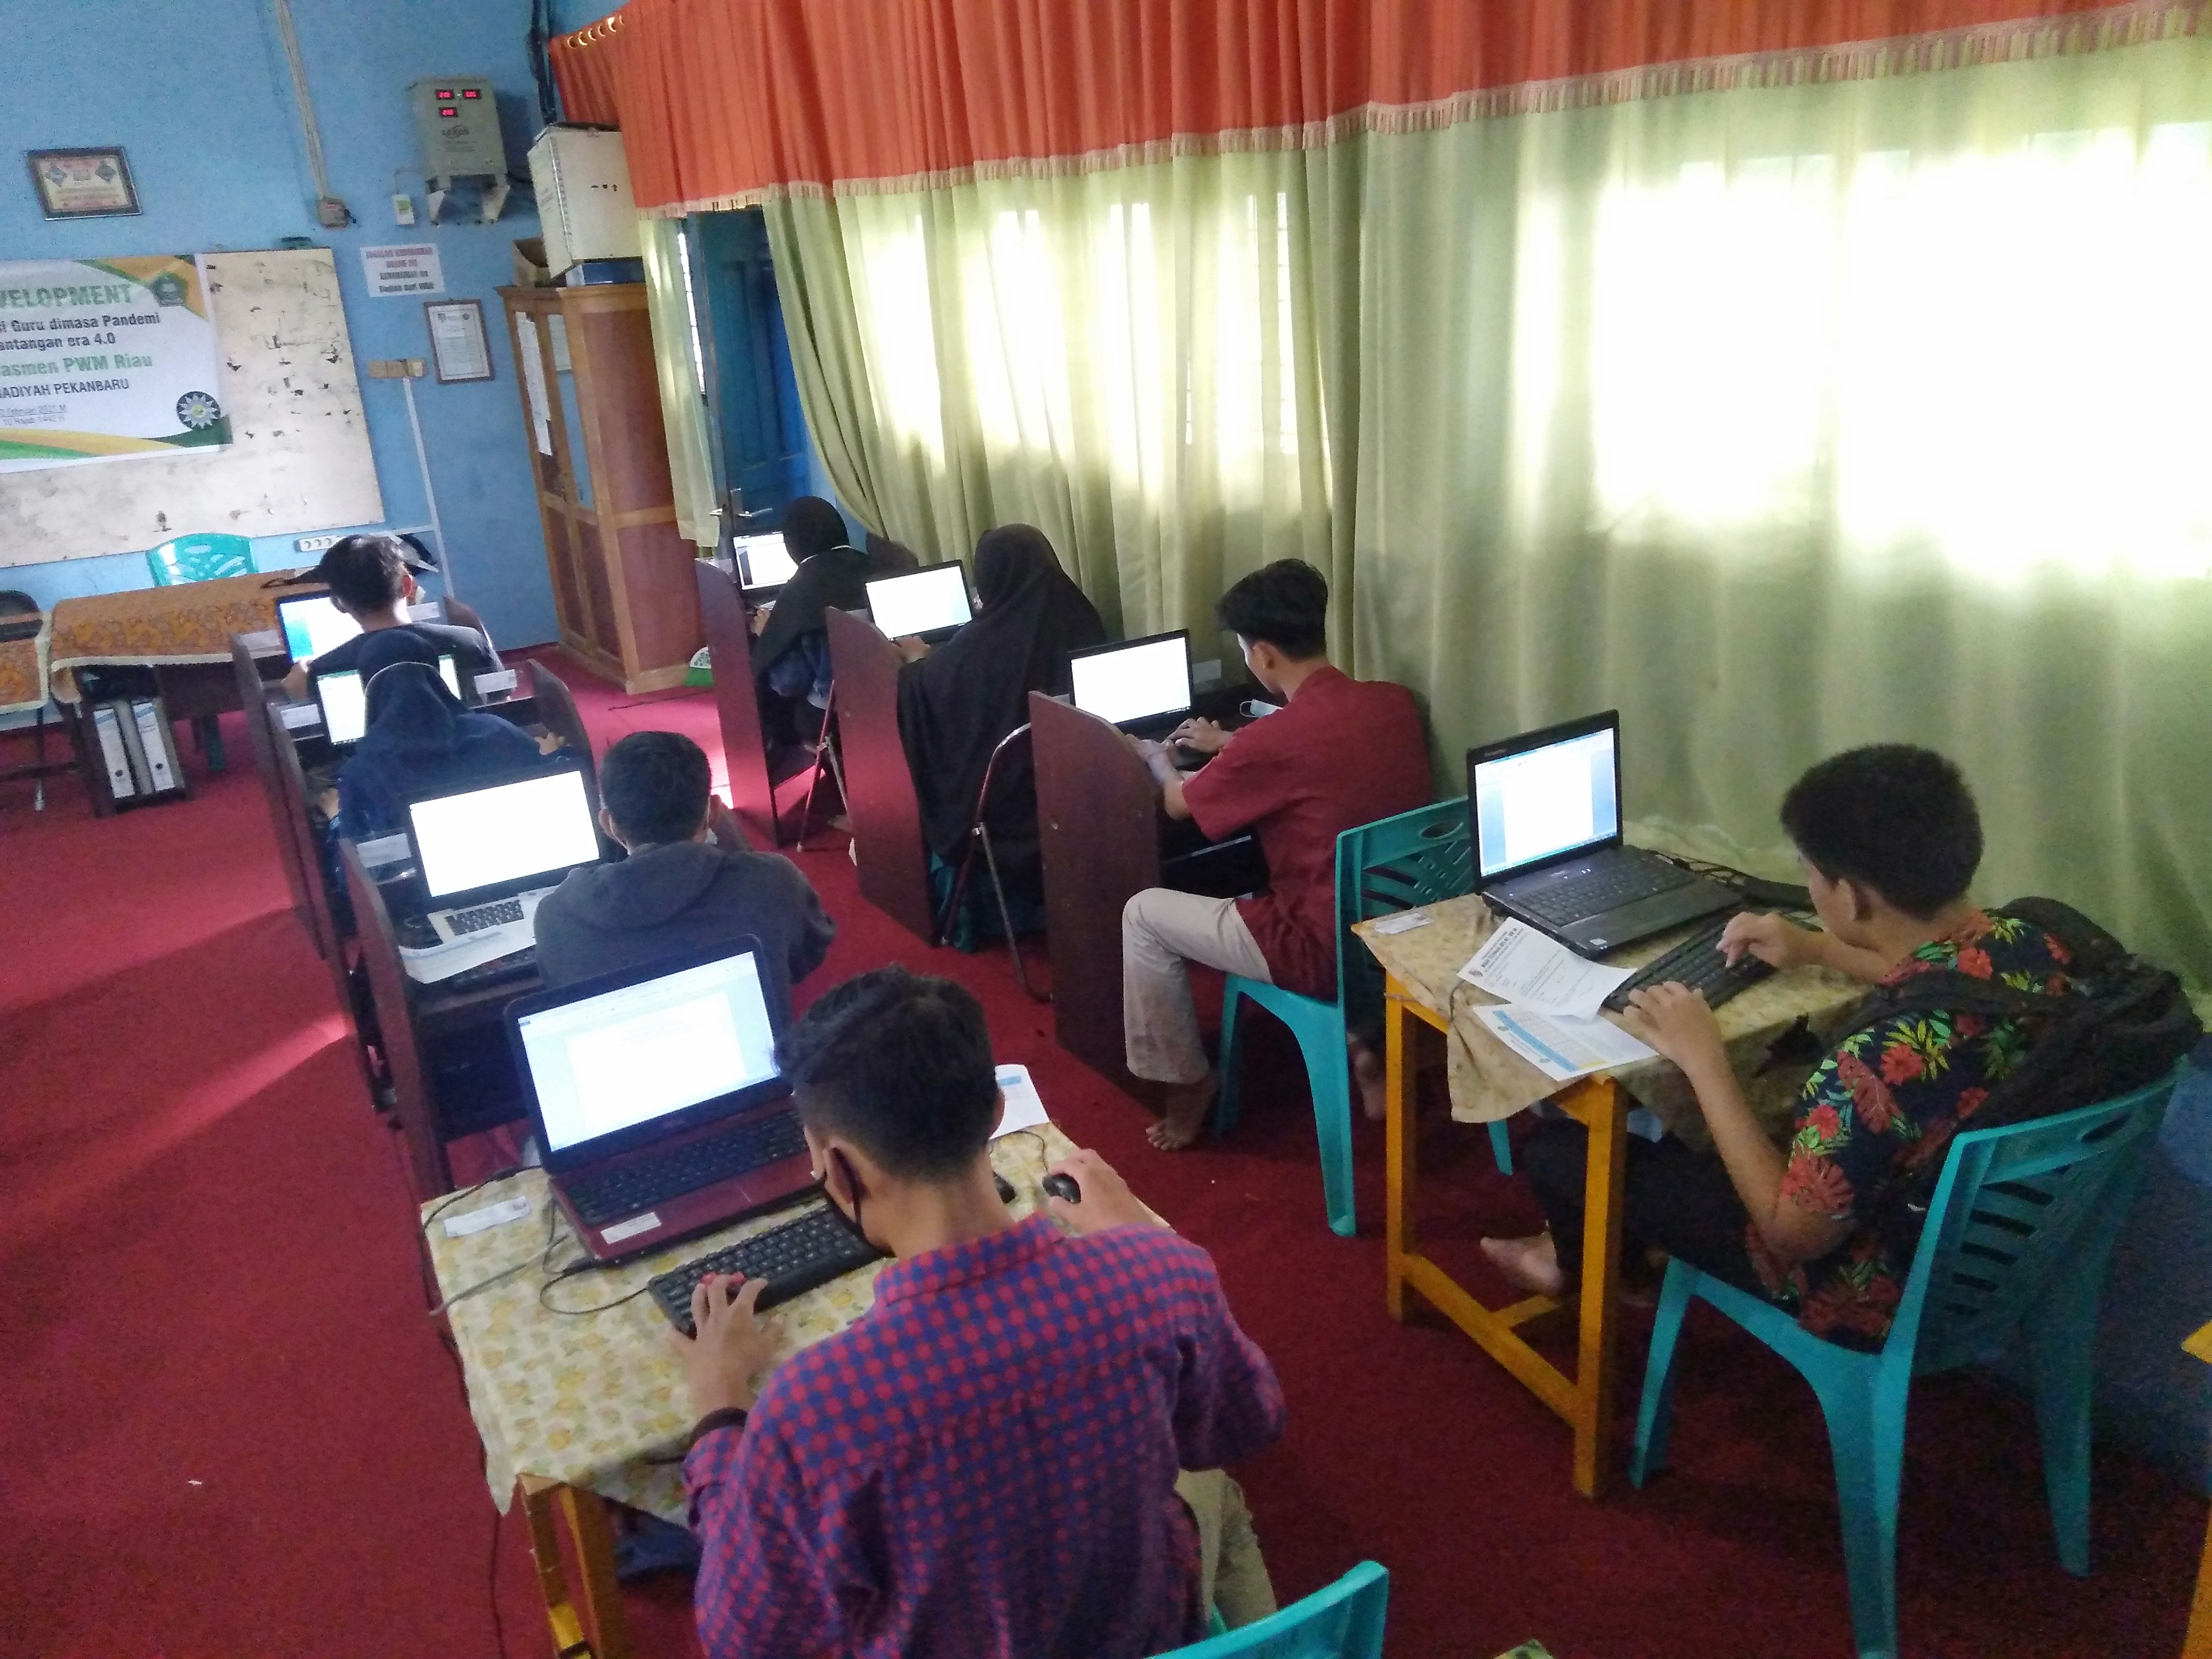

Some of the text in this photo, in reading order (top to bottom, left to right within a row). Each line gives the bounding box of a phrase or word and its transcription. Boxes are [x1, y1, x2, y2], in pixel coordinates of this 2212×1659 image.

[11, 320, 45, 332] Guru
[49, 318, 99, 330] dimasa
[102, 312, 161, 327] Pandemi
[68, 336, 91, 347] era
[95, 332, 116, 345] 4.0
[63, 355, 109, 372] PWM
[114, 353, 153, 368] Riau
[0, 378, 129, 398] ADIYAH PEKANBARU
